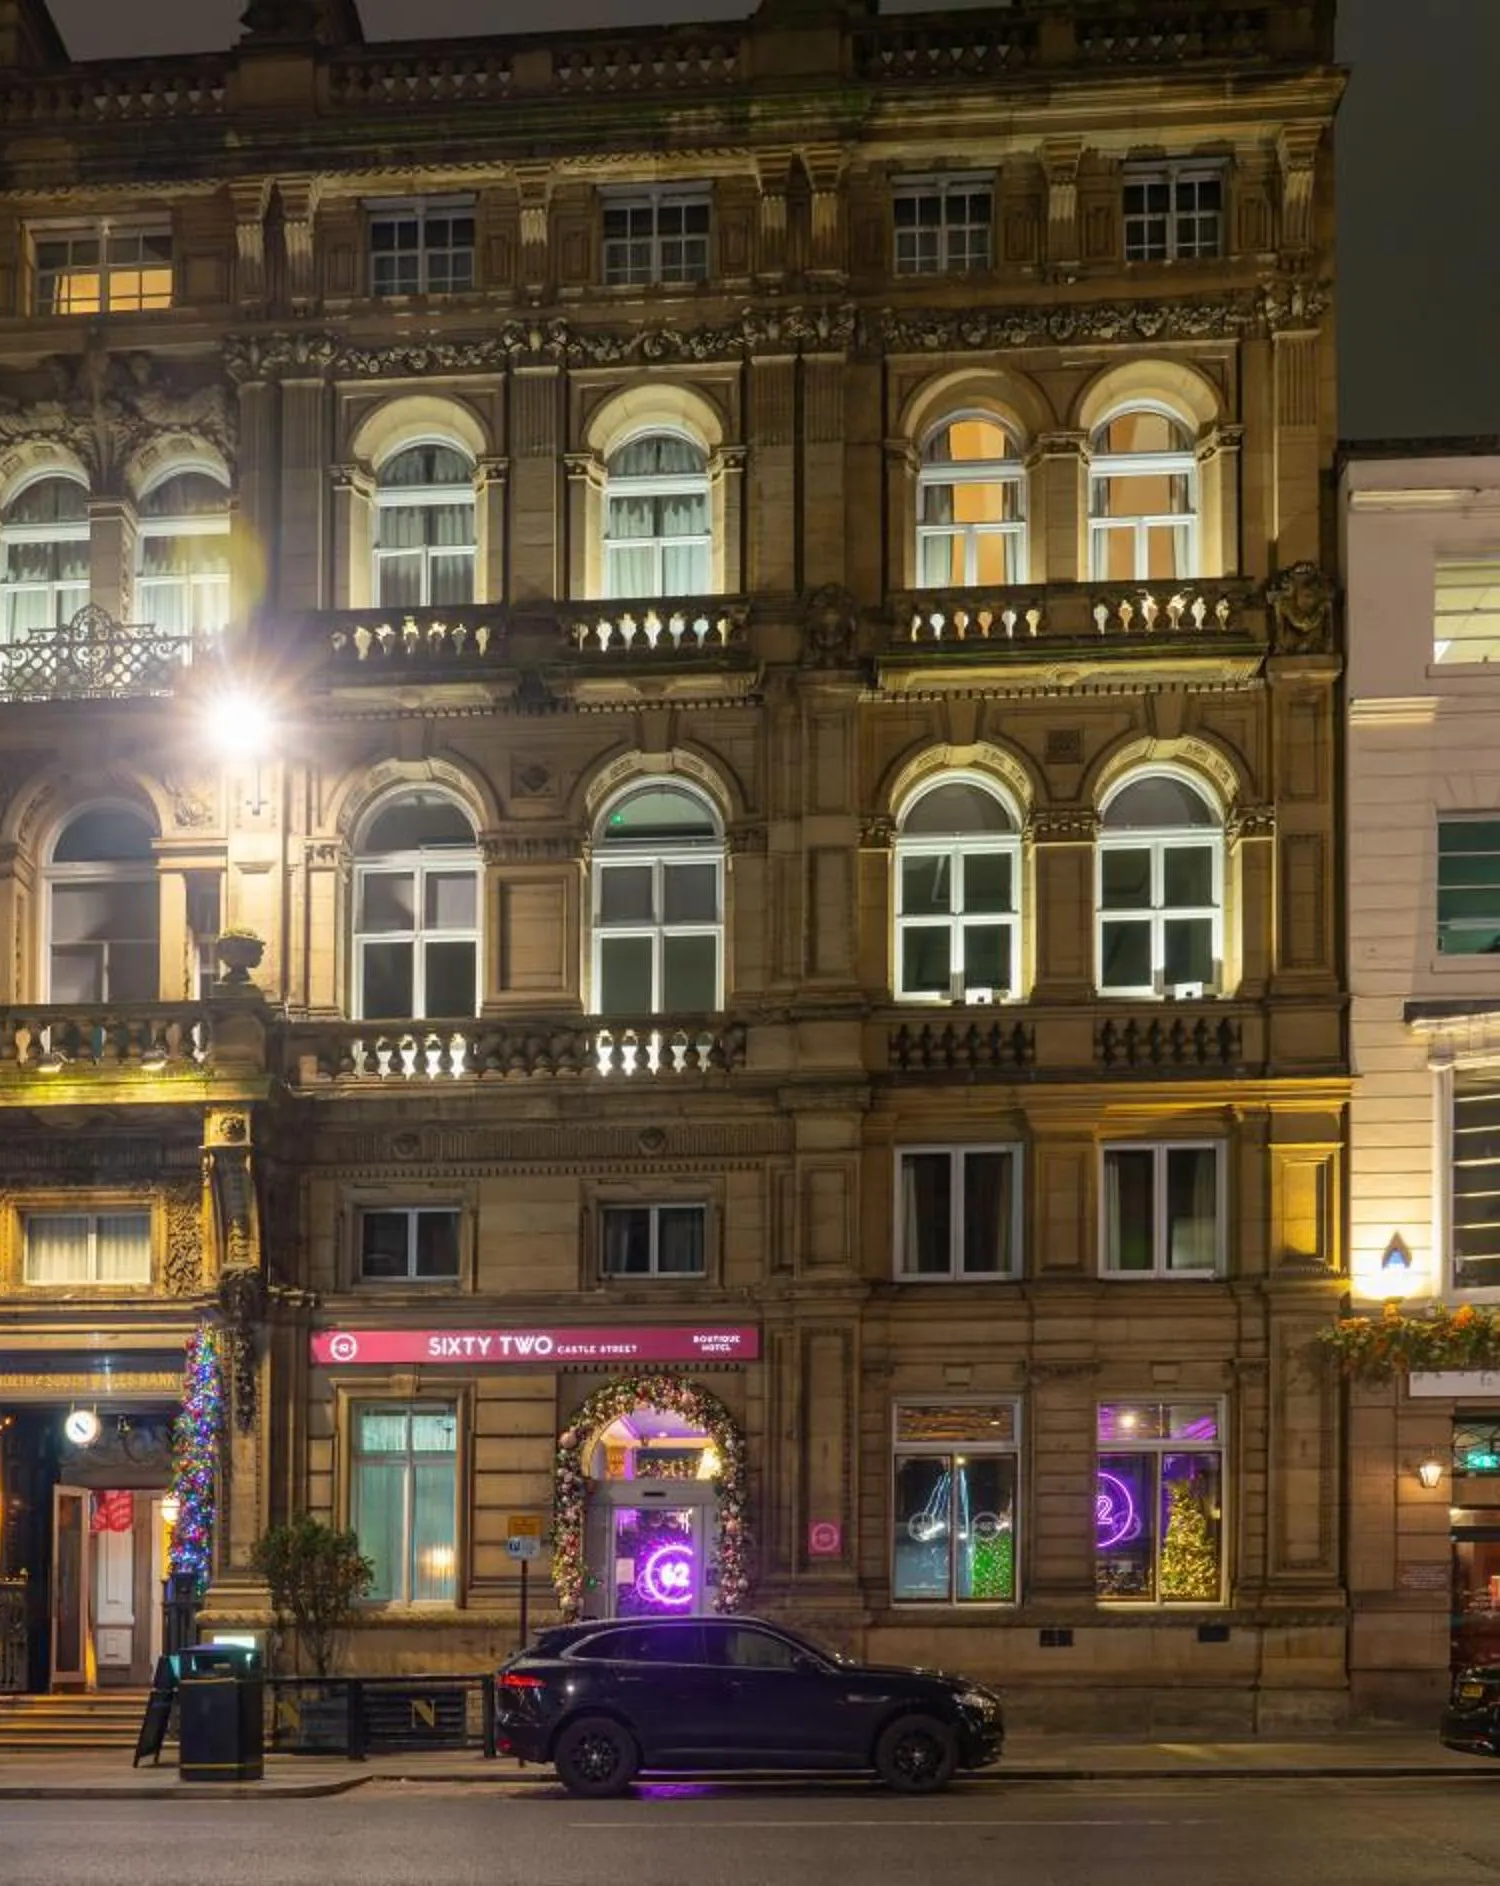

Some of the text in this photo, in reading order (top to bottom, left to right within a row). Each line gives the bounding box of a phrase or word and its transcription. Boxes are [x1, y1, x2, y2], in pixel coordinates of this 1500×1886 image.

[428, 1335, 638, 1356] SIXTY TWO CASTLE STREET
[692, 1334, 741, 1344] BOUTIQUE
[701, 1343, 731, 1353] HOTEL
[660, 1562, 690, 1587] 62
[411, 1699, 436, 1729] N
